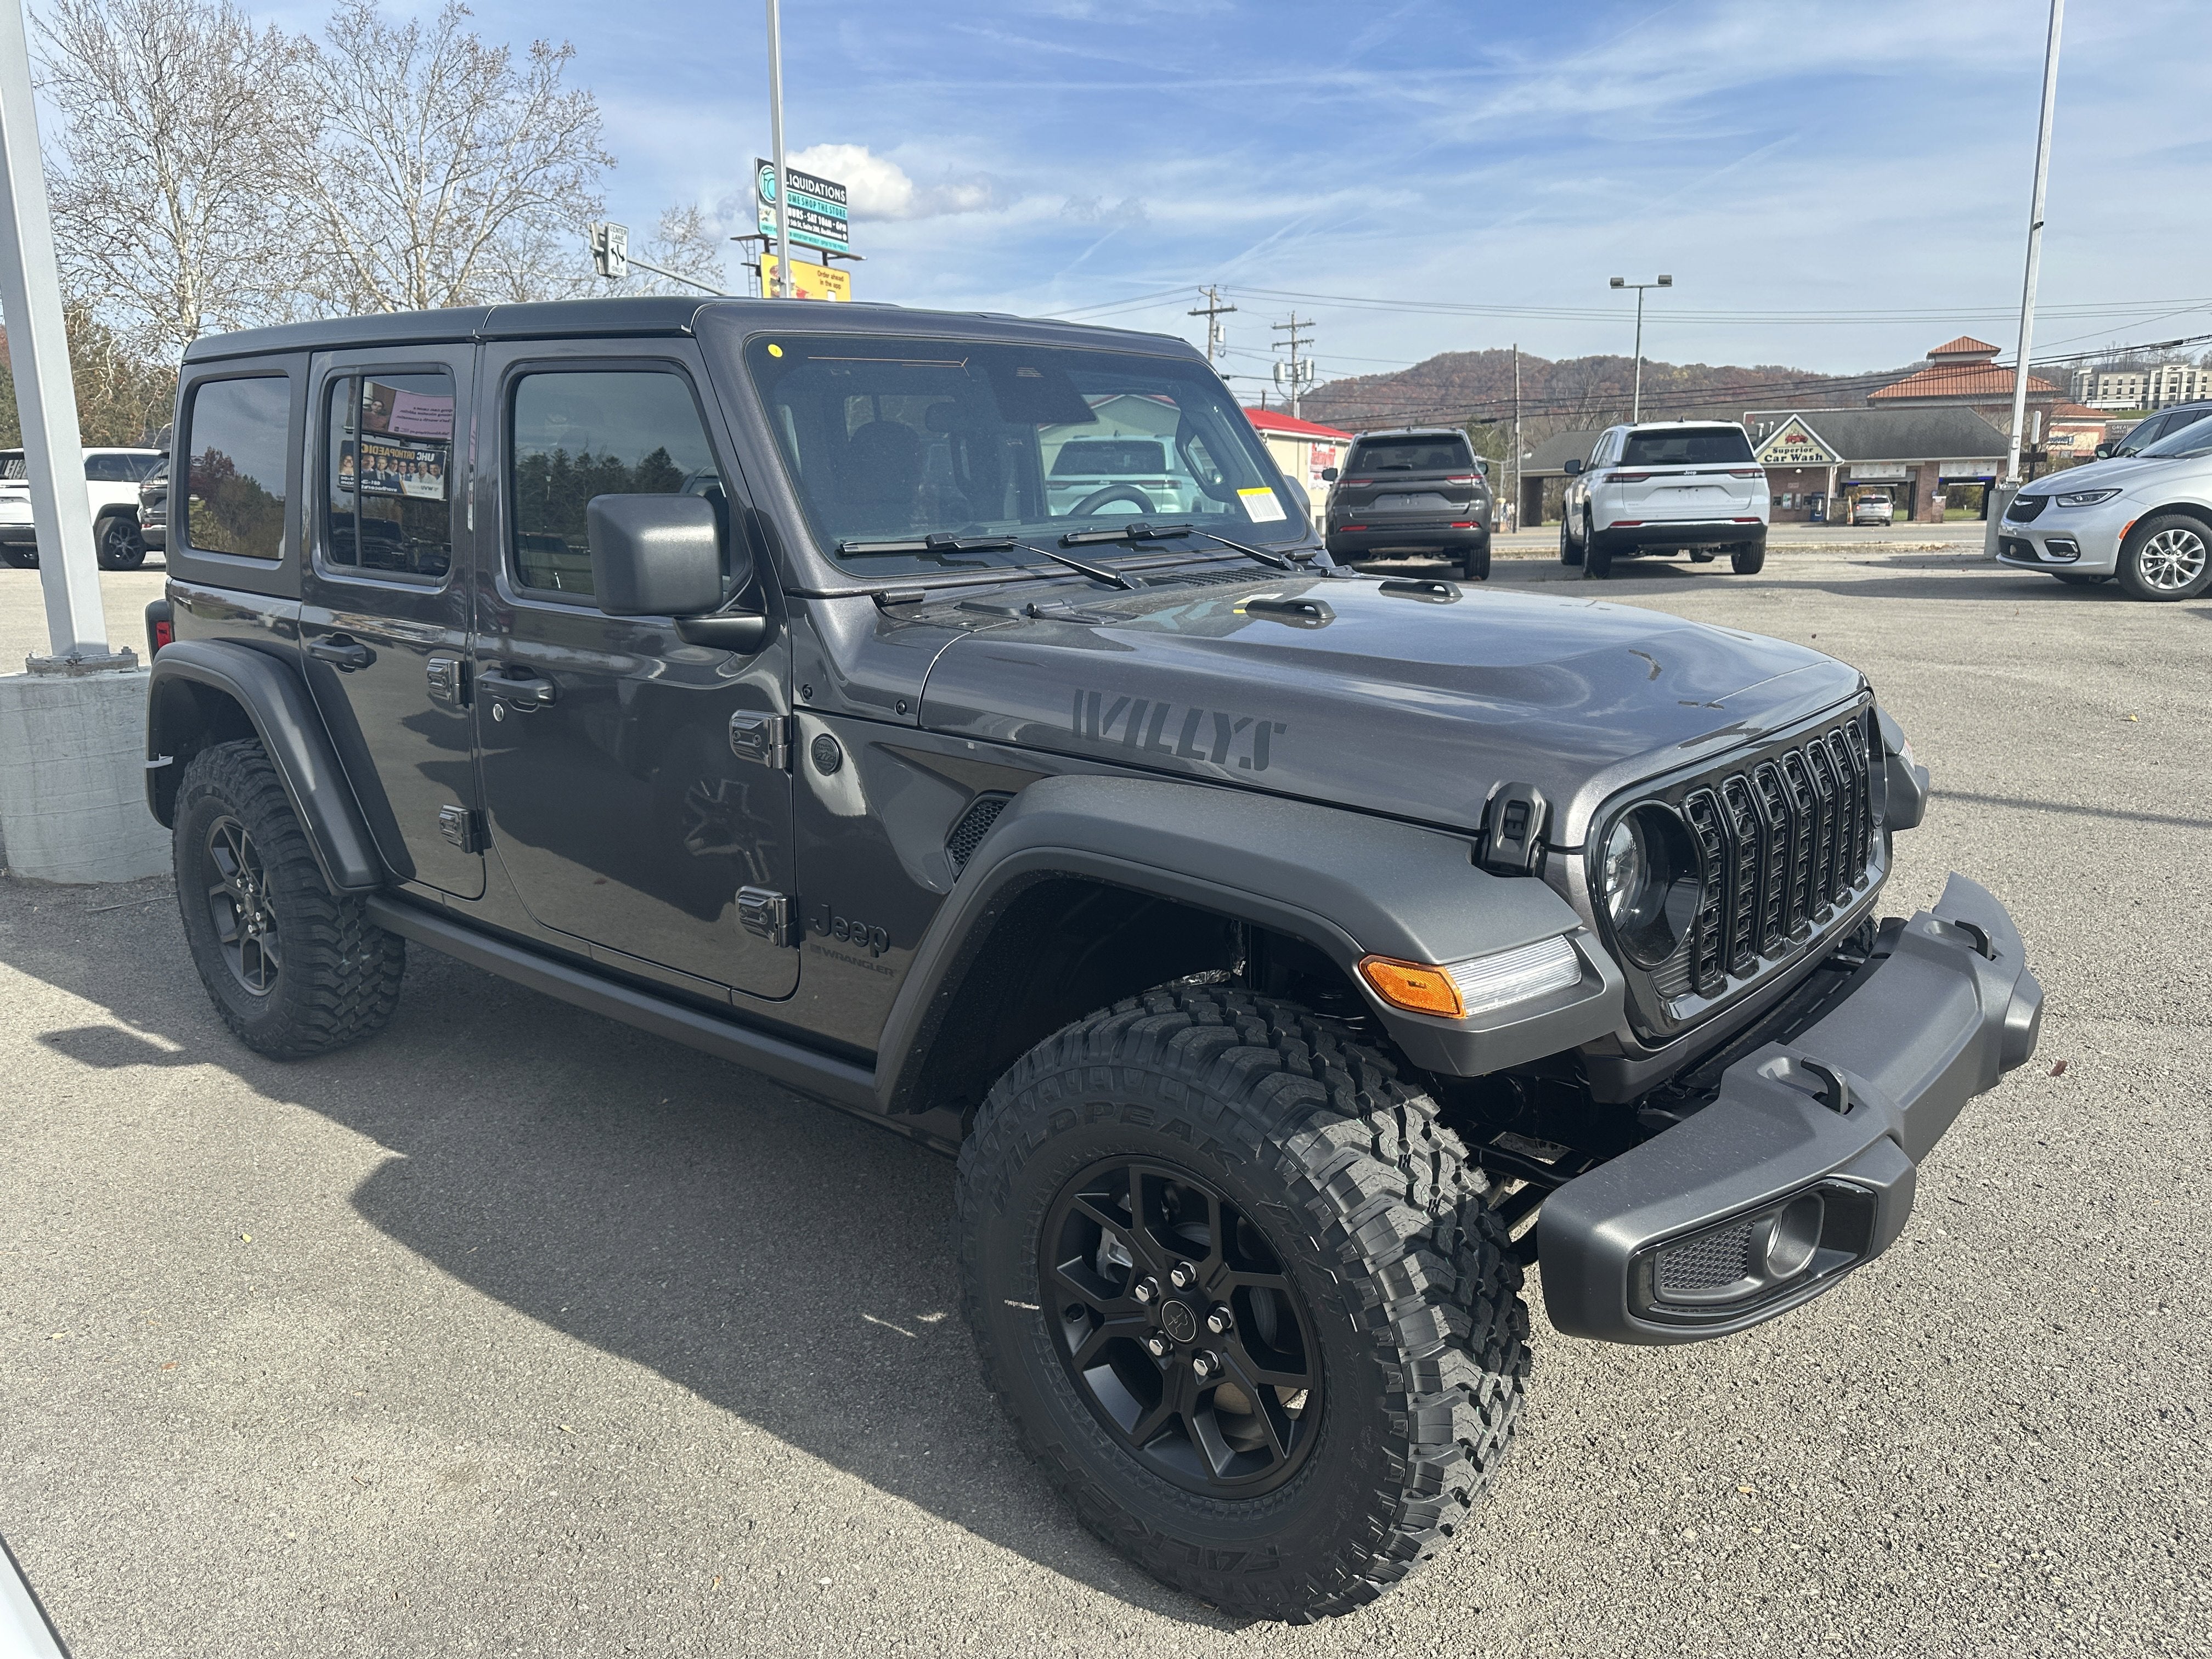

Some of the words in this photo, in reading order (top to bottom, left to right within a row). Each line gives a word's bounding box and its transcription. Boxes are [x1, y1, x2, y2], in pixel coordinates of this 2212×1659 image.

[787, 207, 804, 219] HURS
[802, 198, 816, 208] SHOP
[817, 202, 828, 213] THE
[829, 206, 846, 218] STORE
[610, 225, 627, 235] CENTER
[612, 233, 624, 242] LANE
[817, 270, 830, 278] Order
[1073, 689, 1287, 771] WILLYS
[810, 904, 889, 957] Jeep
[823, 947, 895, 977] WRANGLER
